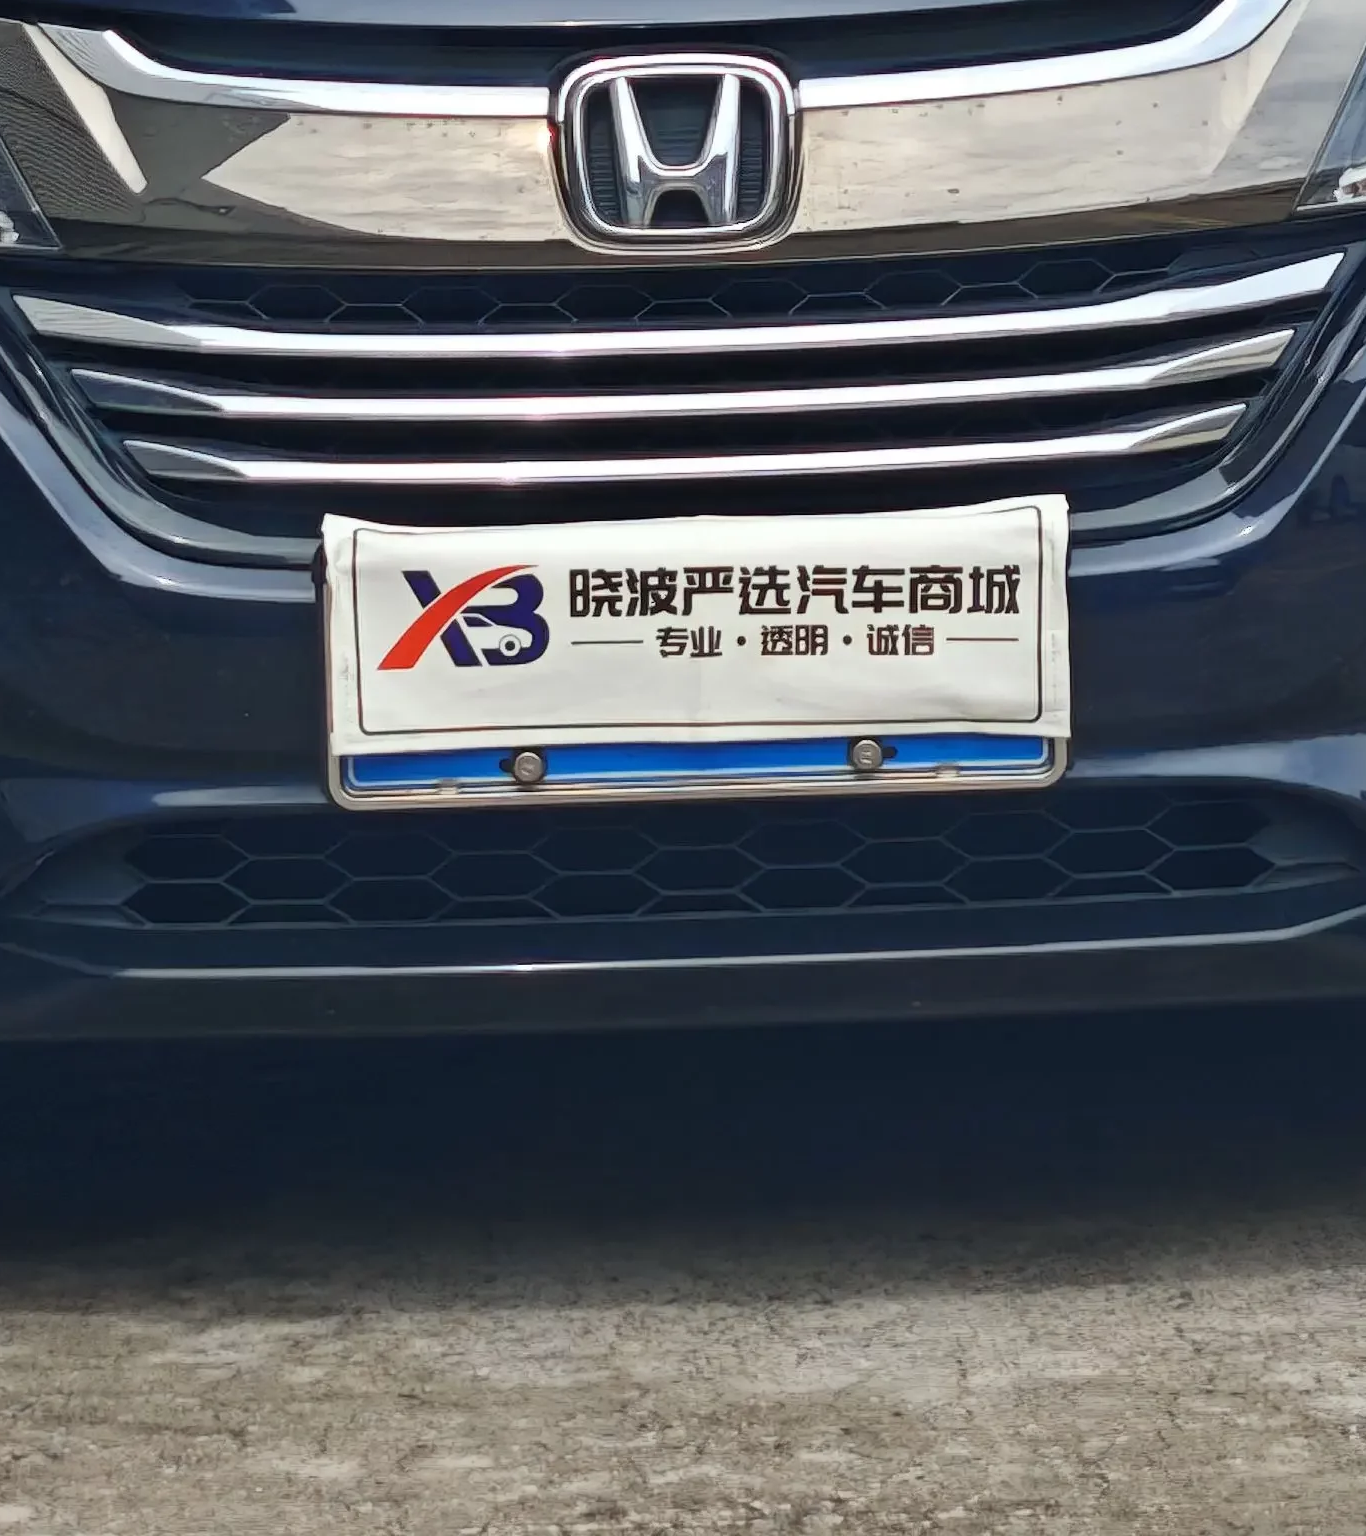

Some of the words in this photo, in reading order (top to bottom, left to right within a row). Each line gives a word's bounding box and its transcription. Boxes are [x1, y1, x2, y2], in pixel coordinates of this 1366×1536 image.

[570, 565, 1020, 617] 晓波严选汽车商城
